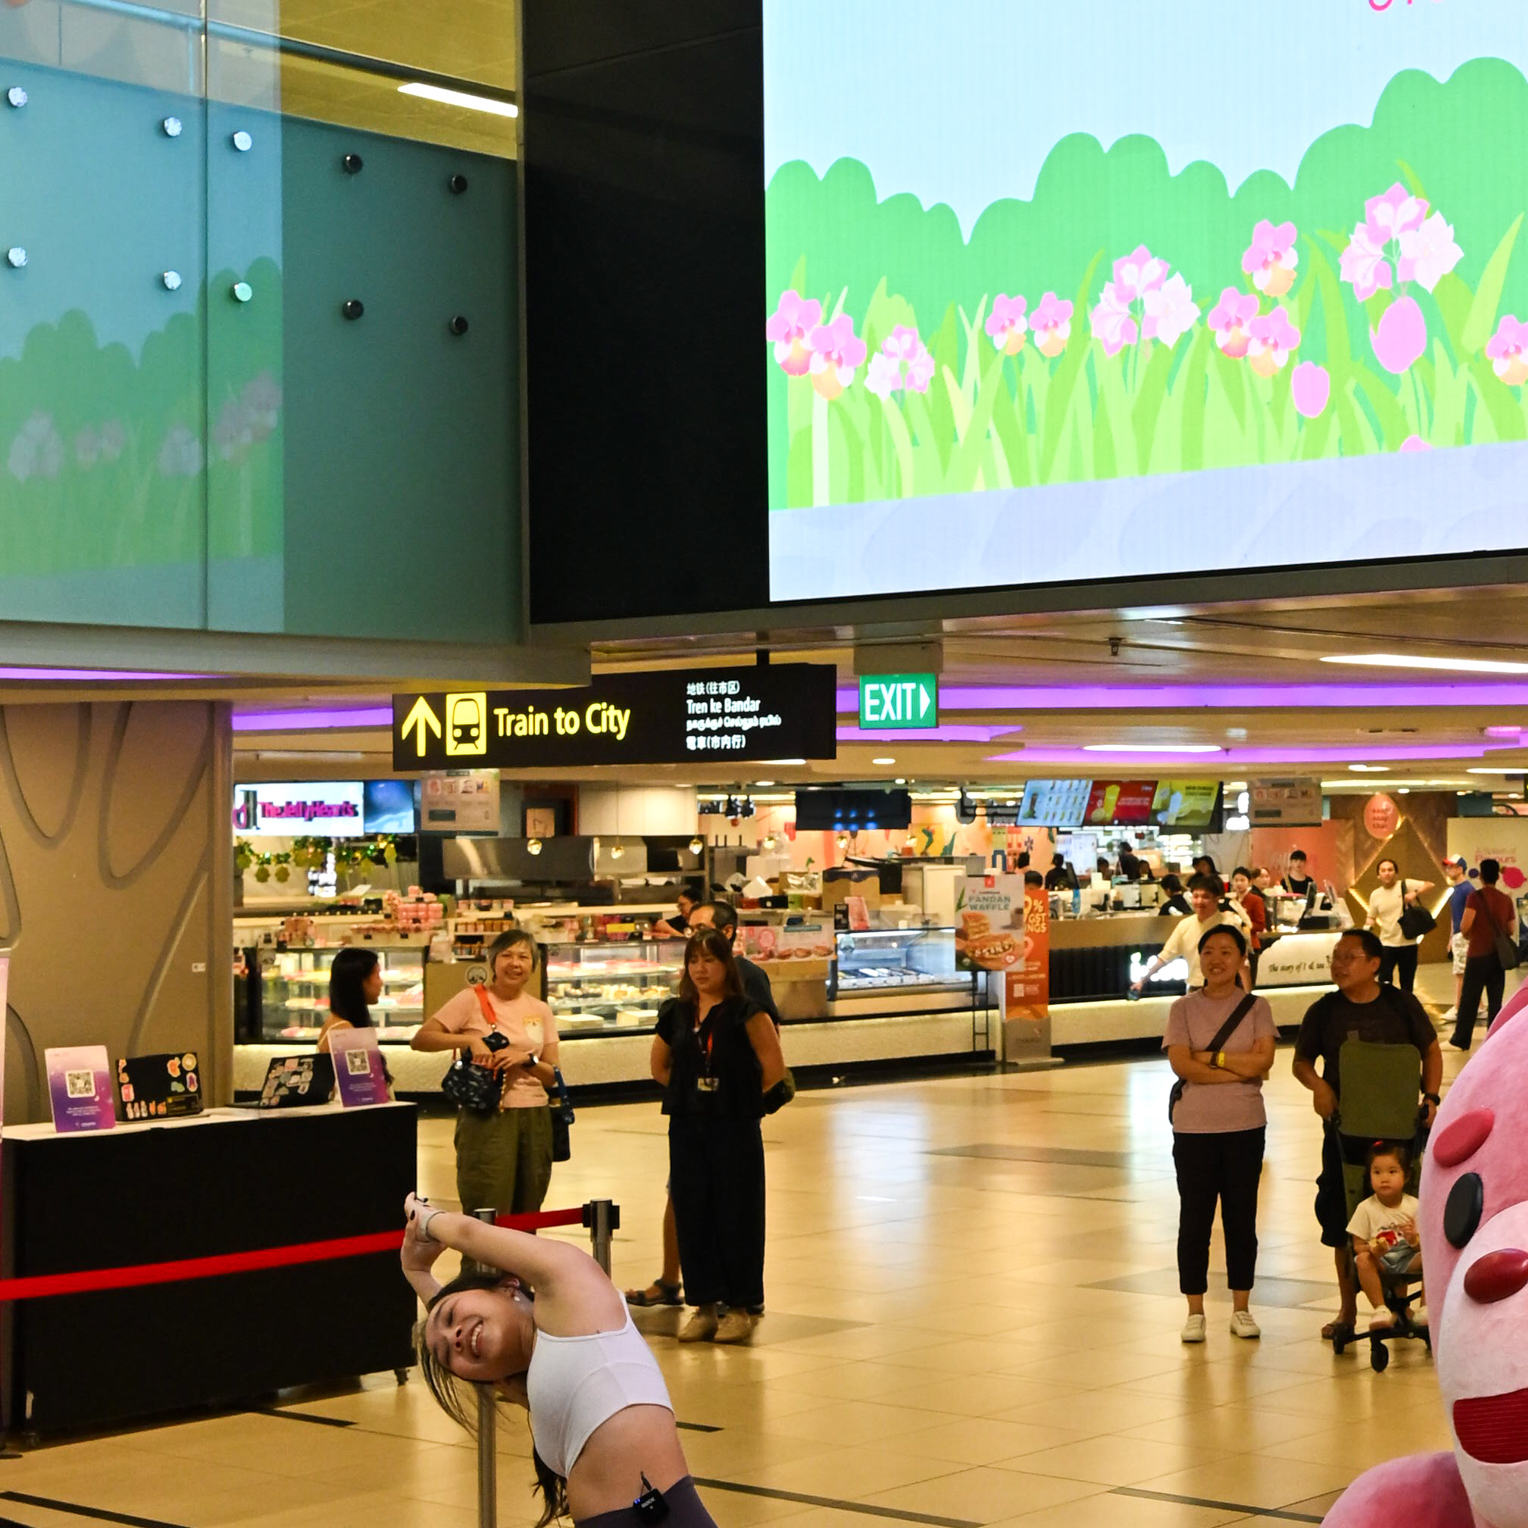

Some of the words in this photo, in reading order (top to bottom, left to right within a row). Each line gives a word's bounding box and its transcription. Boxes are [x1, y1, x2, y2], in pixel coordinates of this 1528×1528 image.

[686, 699, 709, 715] Tren
[710, 698, 723, 714] ke
[724, 696, 761, 713] Bandar
[865, 682, 917, 721] EXIT
[494, 706, 546, 738] Train
[555, 710, 577, 735] to
[586, 702, 631, 741] City
[968, 895, 1011, 903] PANDAN
[969, 903, 1010, 911] WAFFLE
[1028, 912, 1047, 924] GST
